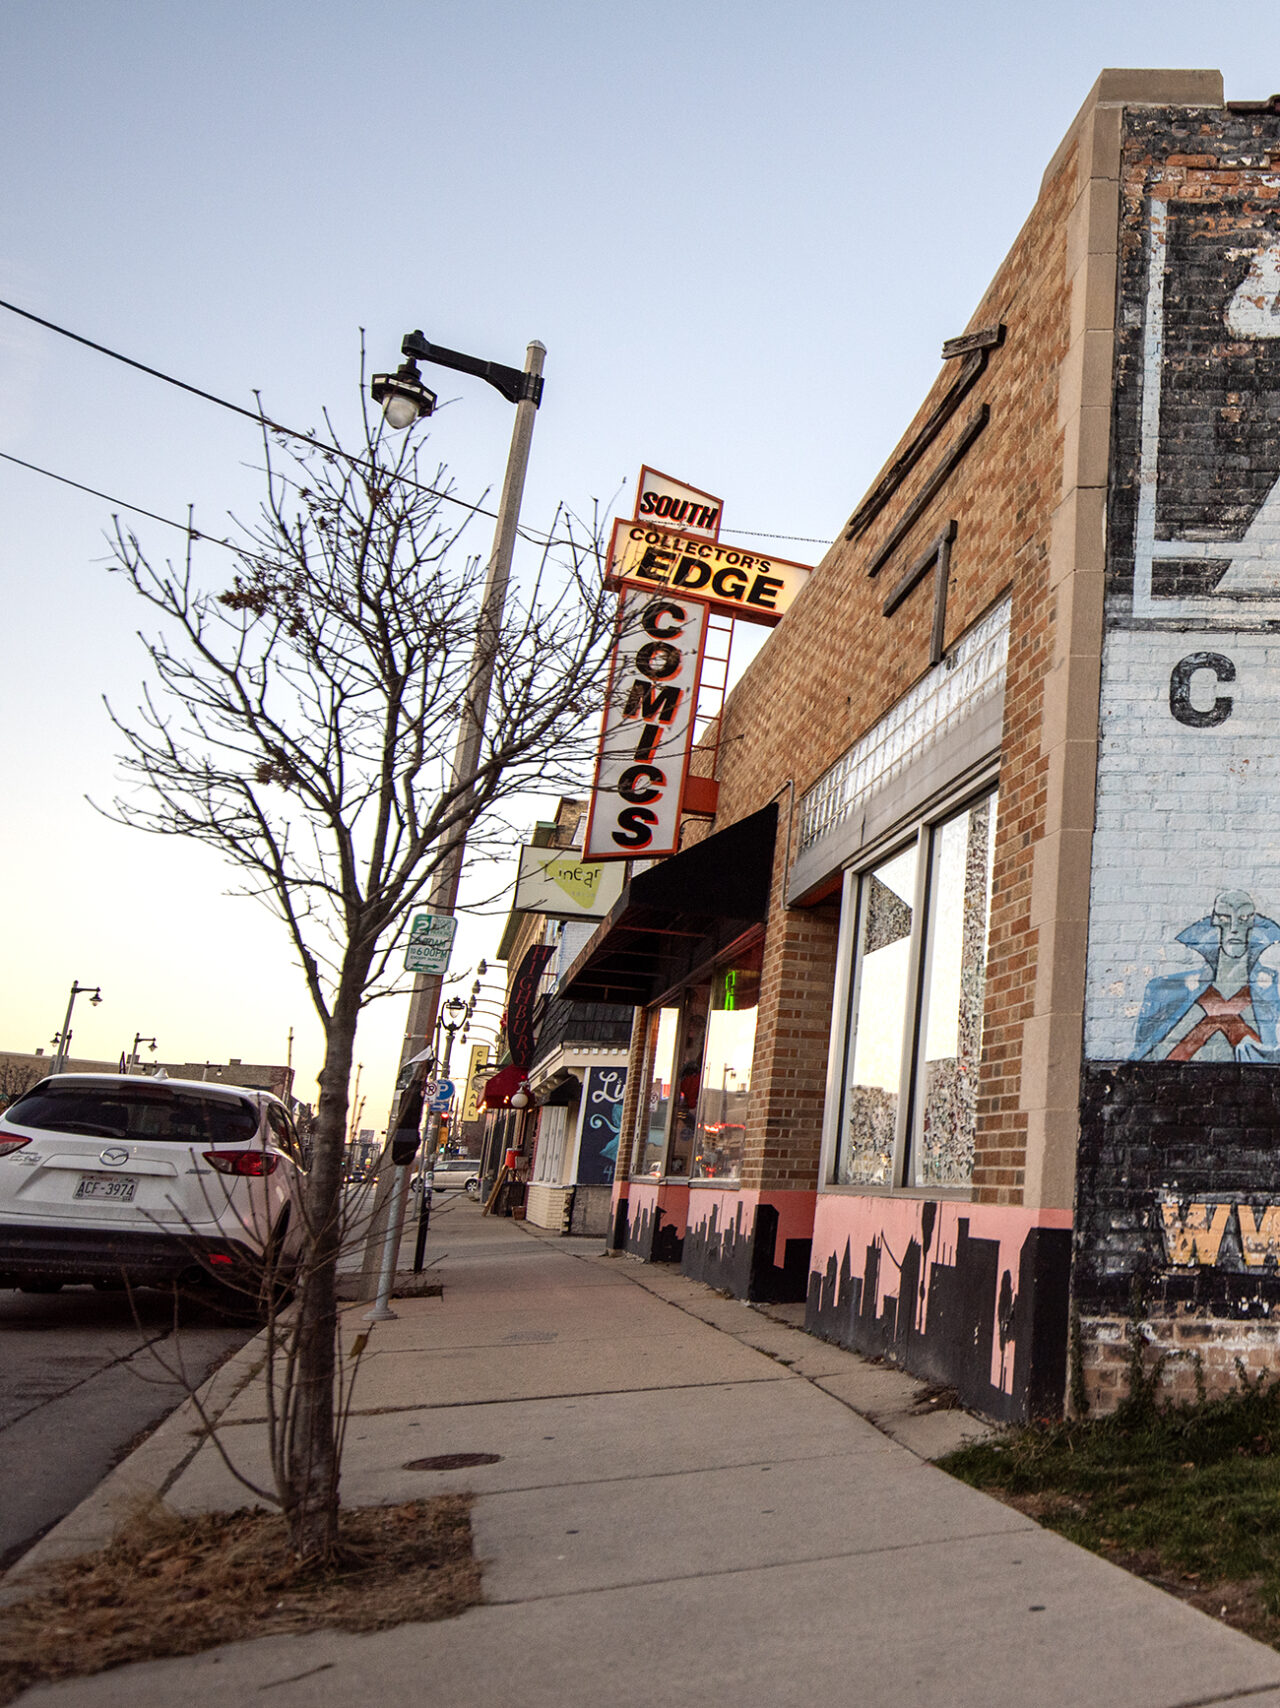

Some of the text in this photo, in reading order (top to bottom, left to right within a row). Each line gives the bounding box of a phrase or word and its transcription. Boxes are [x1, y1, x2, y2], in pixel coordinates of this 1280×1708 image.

[640, 491, 719, 529] SOUTH
[629, 527, 772, 573] COLLECTOR'S
[635, 546, 785, 609] EDGE
[611, 601, 687, 850] COMICS
[415, 920, 430, 933] 2
[513, 945, 548, 1065] HIGHBURY
[77, 1181, 135, 1197] ACF-3974
